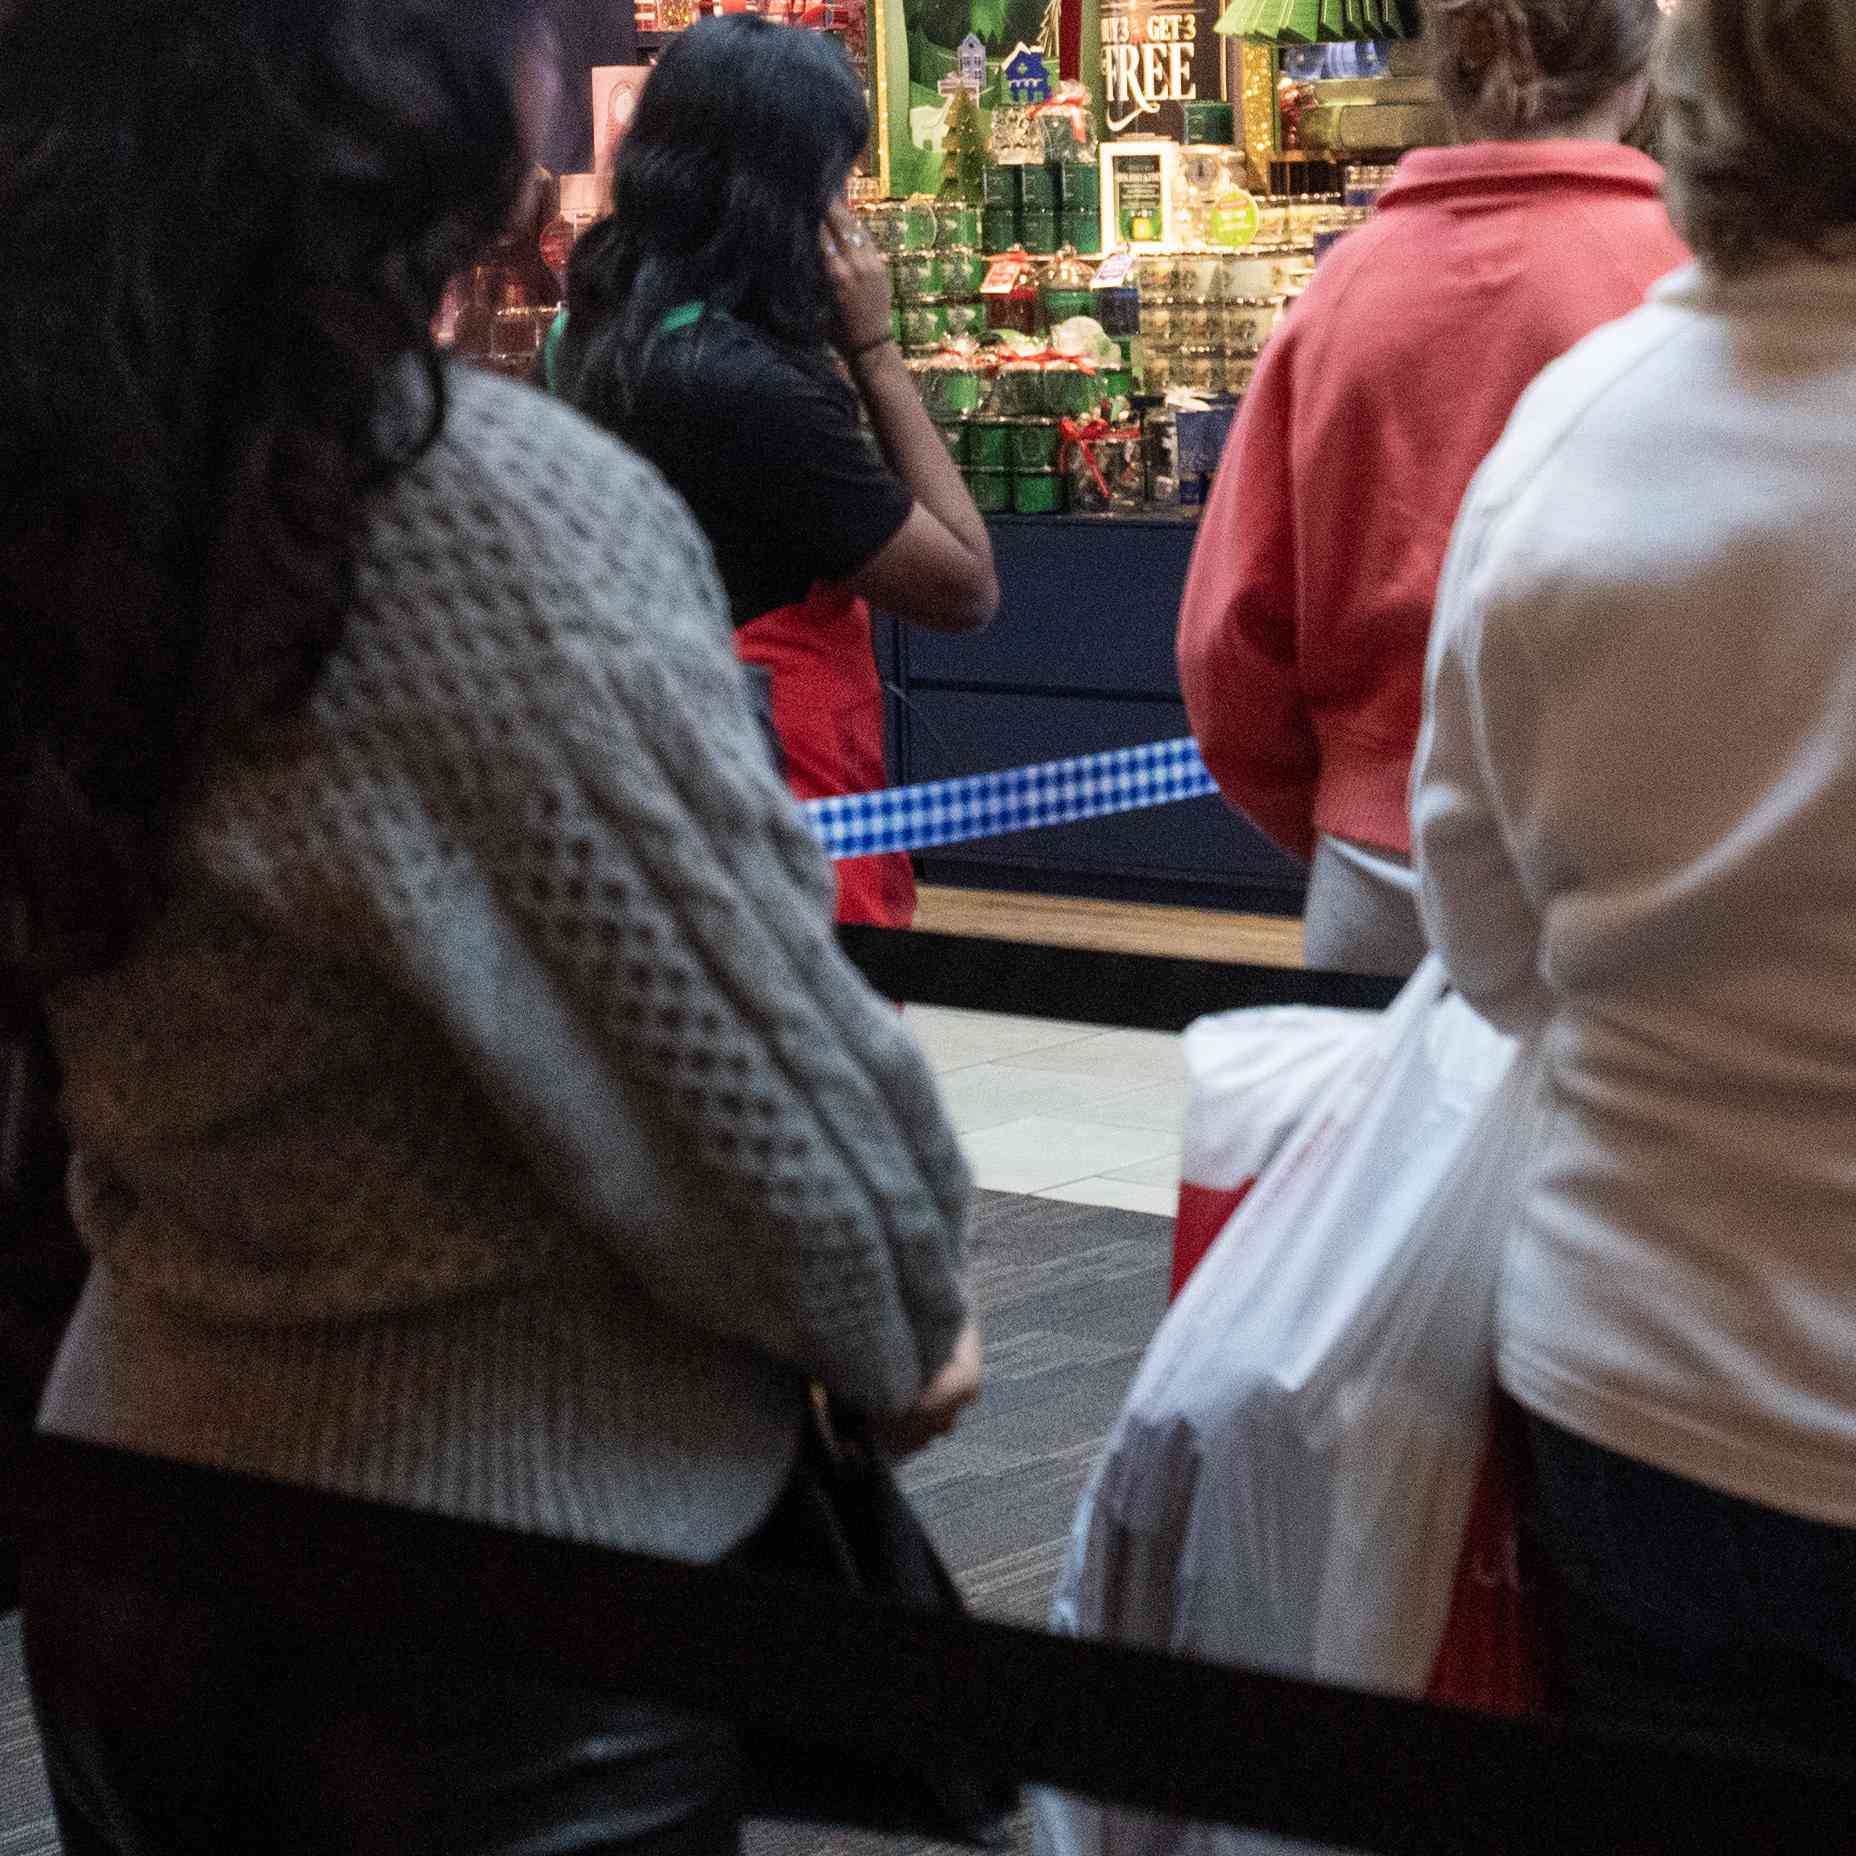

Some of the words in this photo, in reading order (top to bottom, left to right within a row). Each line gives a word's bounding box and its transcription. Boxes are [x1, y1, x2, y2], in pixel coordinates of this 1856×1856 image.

[1147, 15, 1182, 40] GET
[1182, 13, 1197, 40] 3
[1101, 42, 1197, 131] FREE
